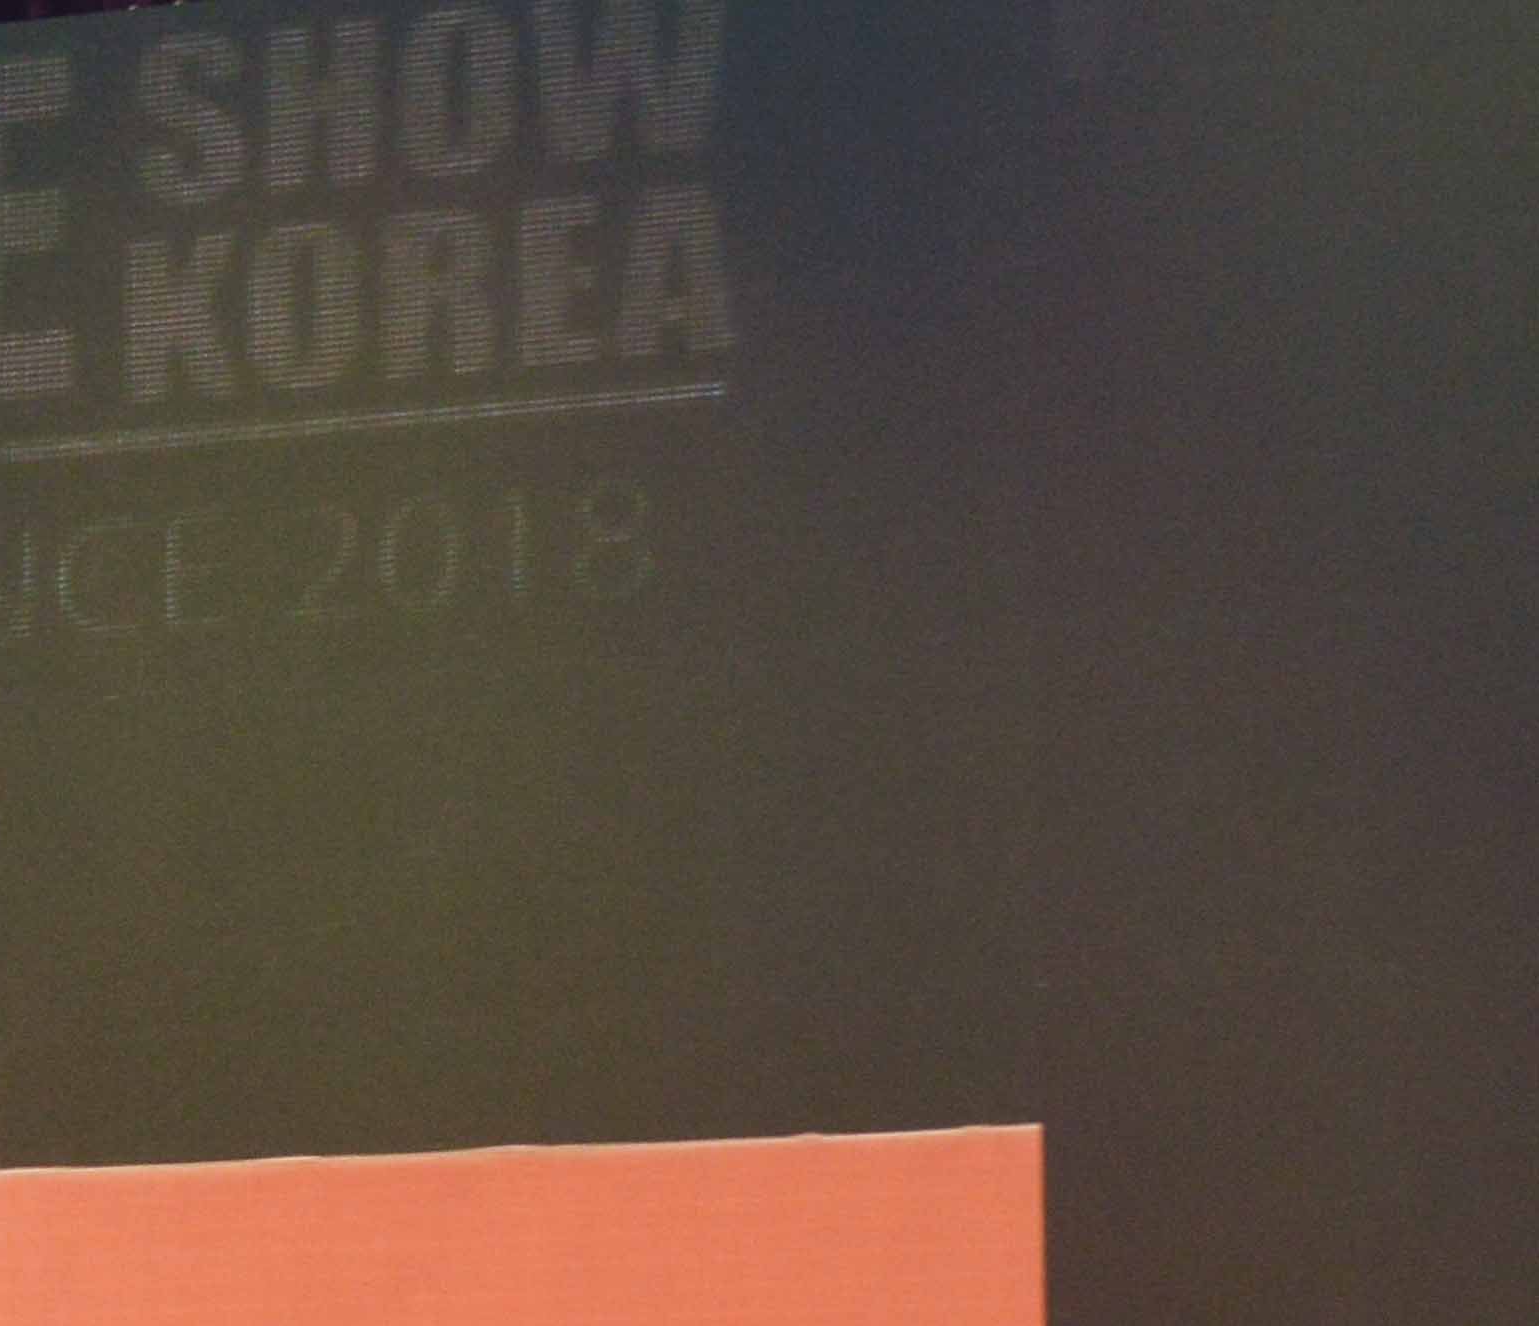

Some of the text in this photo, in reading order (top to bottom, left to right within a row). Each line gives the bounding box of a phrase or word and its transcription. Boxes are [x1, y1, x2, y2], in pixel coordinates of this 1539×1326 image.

[141, 2, 724, 205] SHOW
[123, 184, 738, 398] KOREA
[298, 478, 655, 620] 2018
